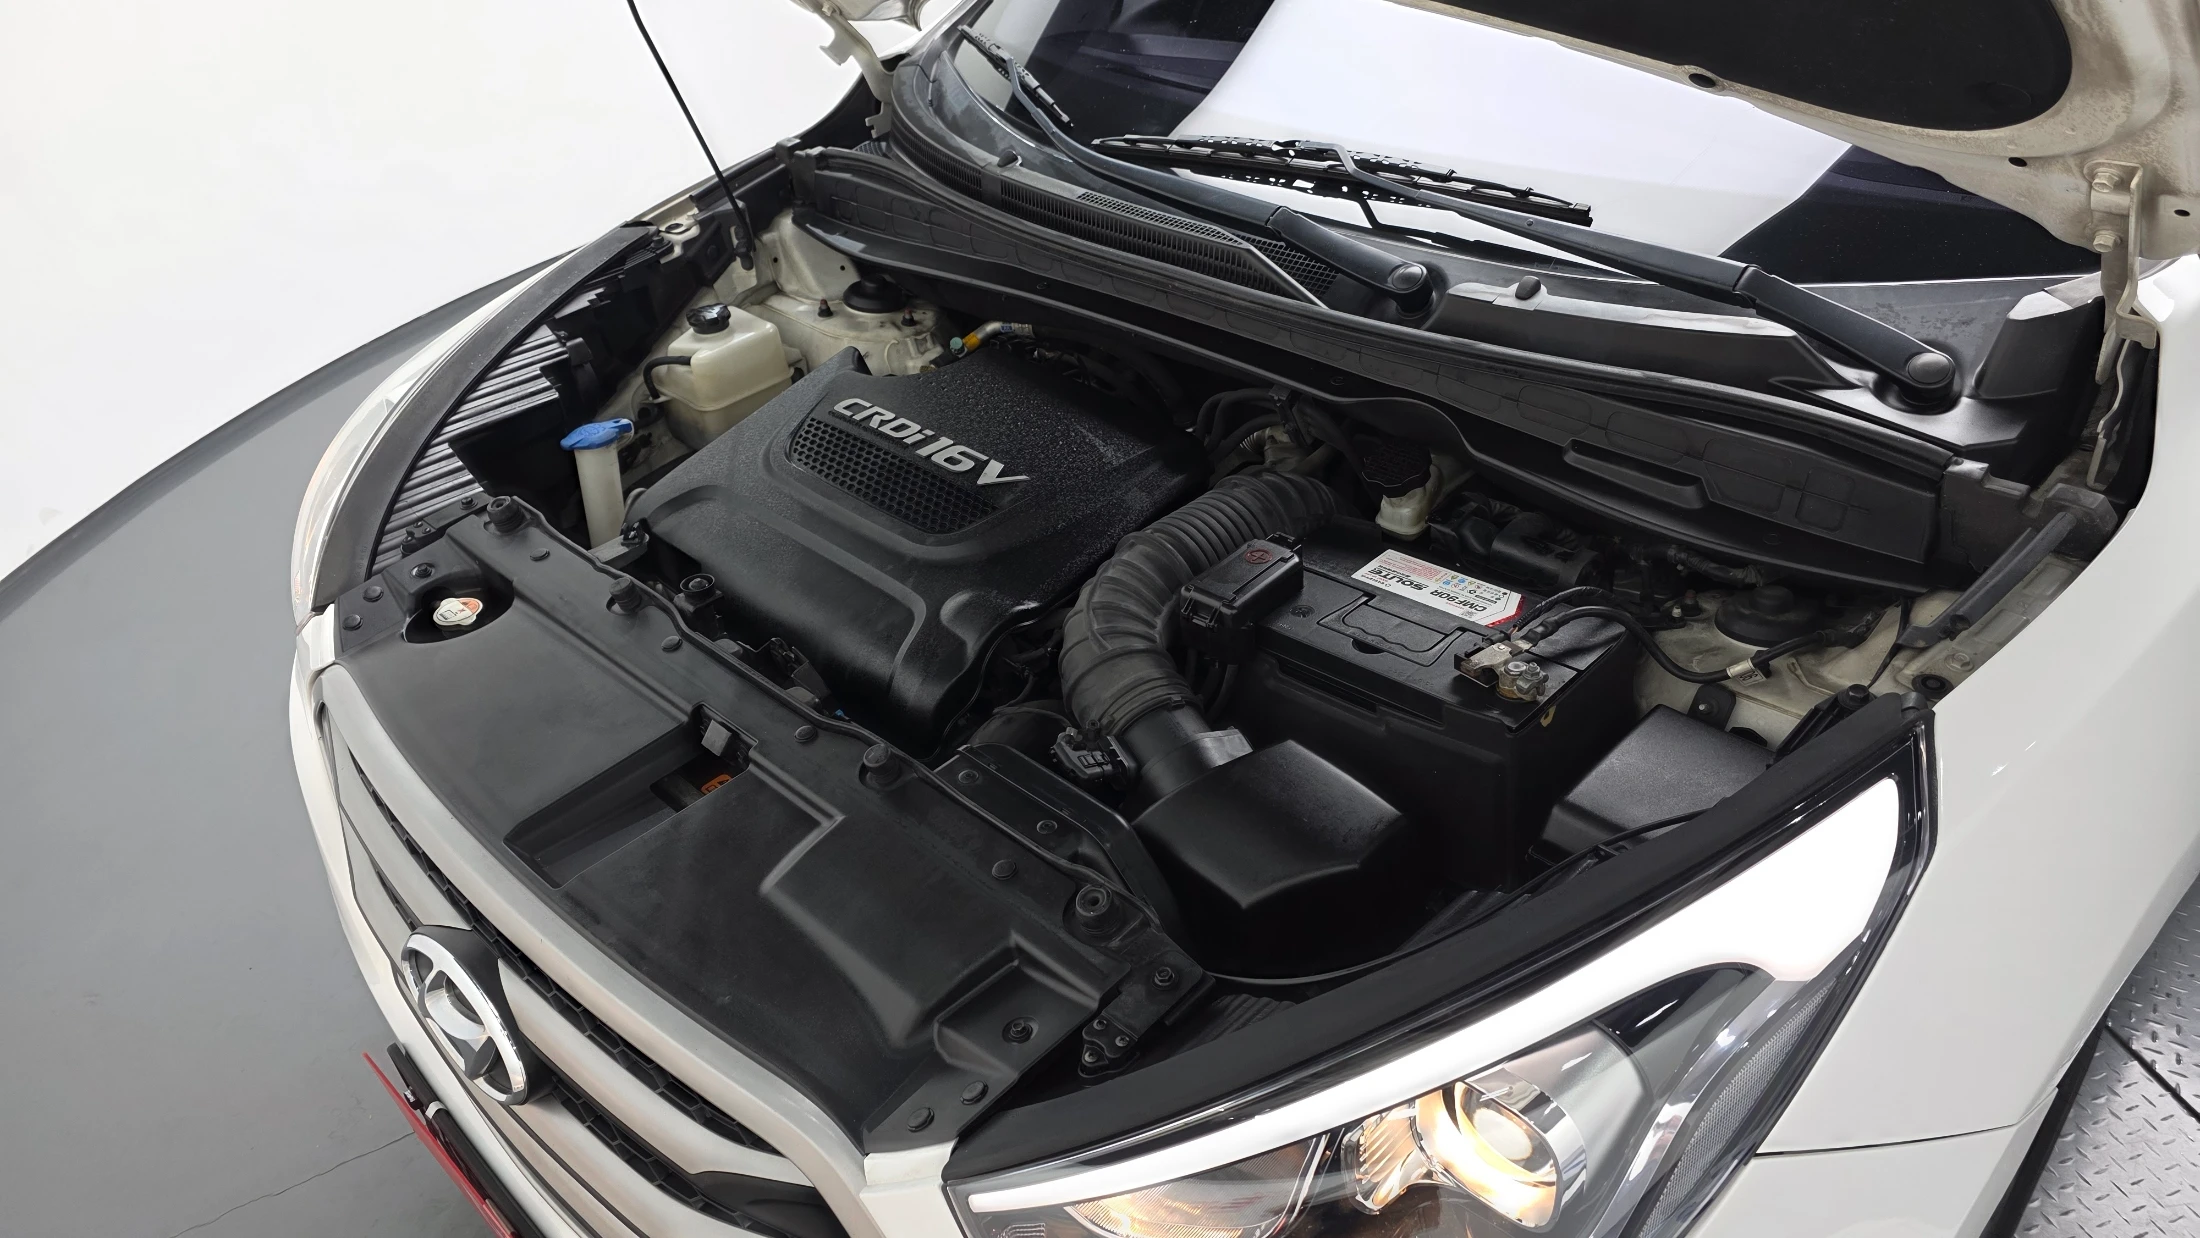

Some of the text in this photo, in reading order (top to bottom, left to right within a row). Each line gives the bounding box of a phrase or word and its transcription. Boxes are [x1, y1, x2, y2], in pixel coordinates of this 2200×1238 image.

[833, 398, 1031, 485] CRDi 16V
[1368, 567, 1430, 591] SOLITE
[1430, 589, 1488, 612] CMF90R
